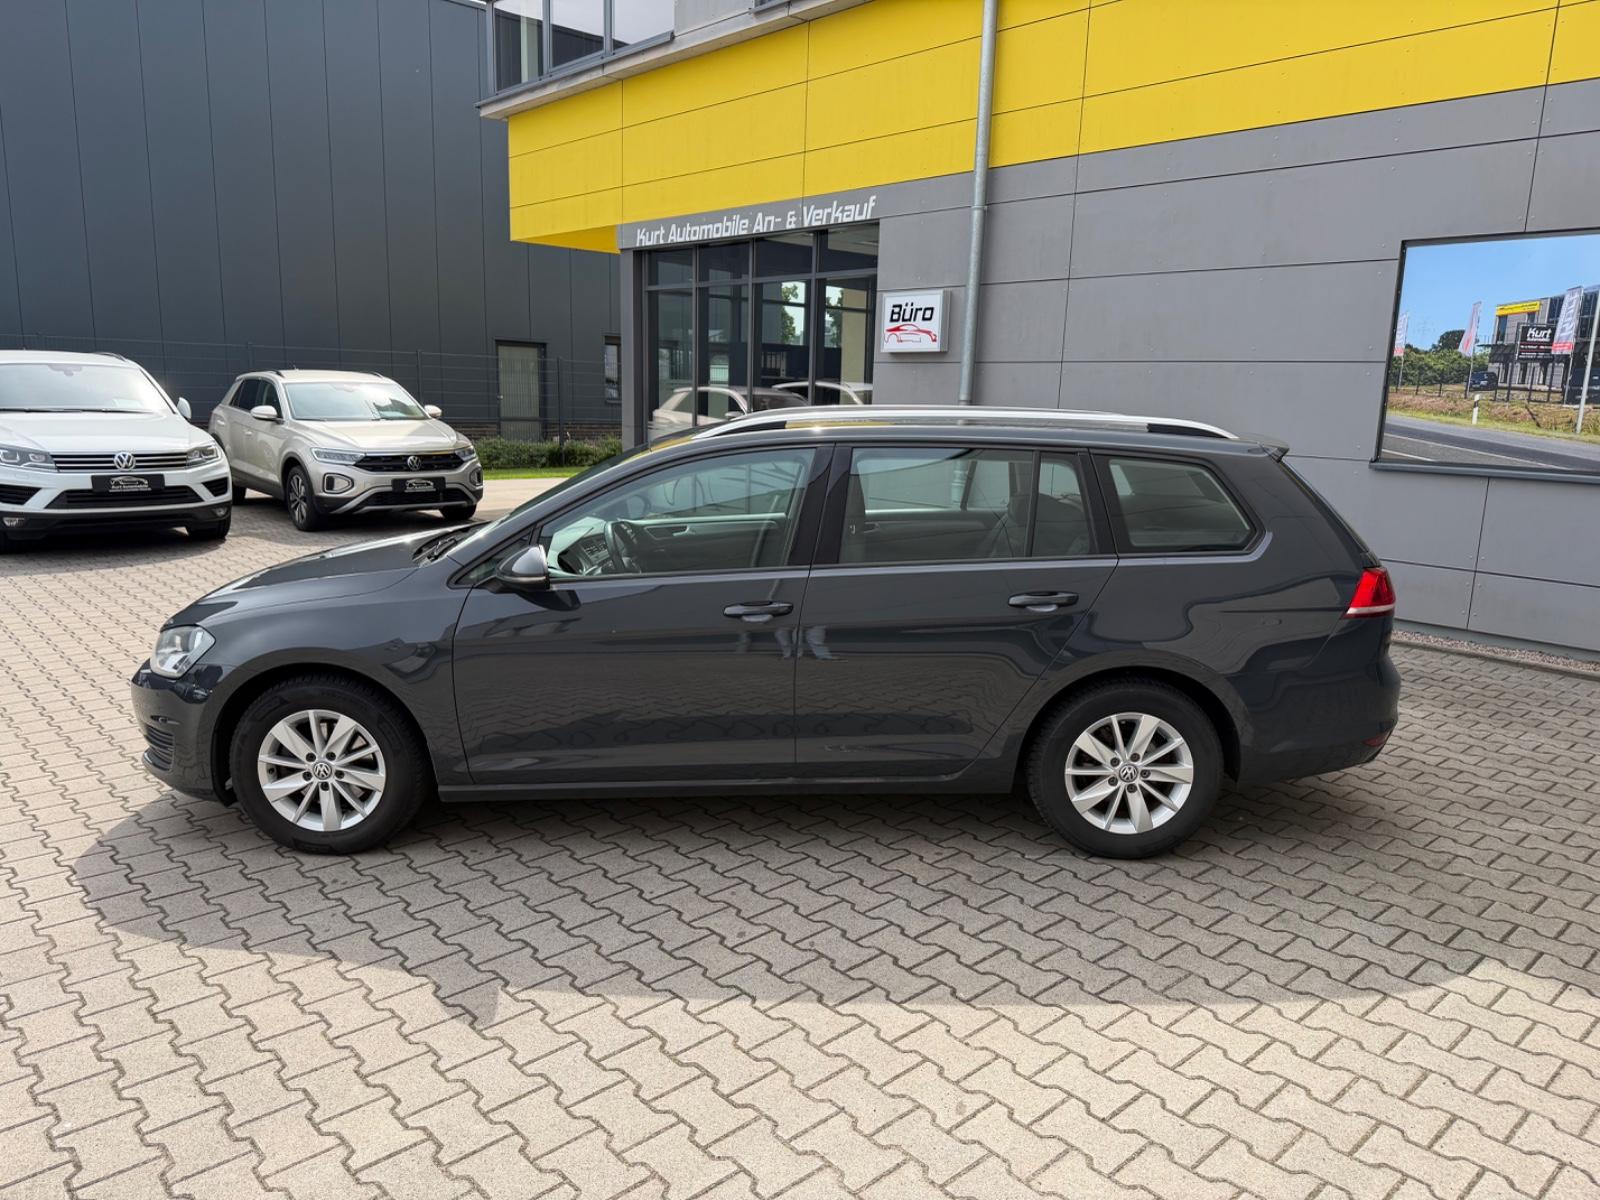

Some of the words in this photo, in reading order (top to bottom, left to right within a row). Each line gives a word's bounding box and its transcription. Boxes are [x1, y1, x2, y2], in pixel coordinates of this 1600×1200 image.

[636, 225, 665, 247] Kurt
[668, 214, 749, 244] Automobile
[753, 212, 782, 233] An-
[785, 210, 797, 229] &
[803, 195, 877, 227] Verkauf
[889, 302, 935, 322] Büro
[1526, 327, 1552, 338] Kurt
